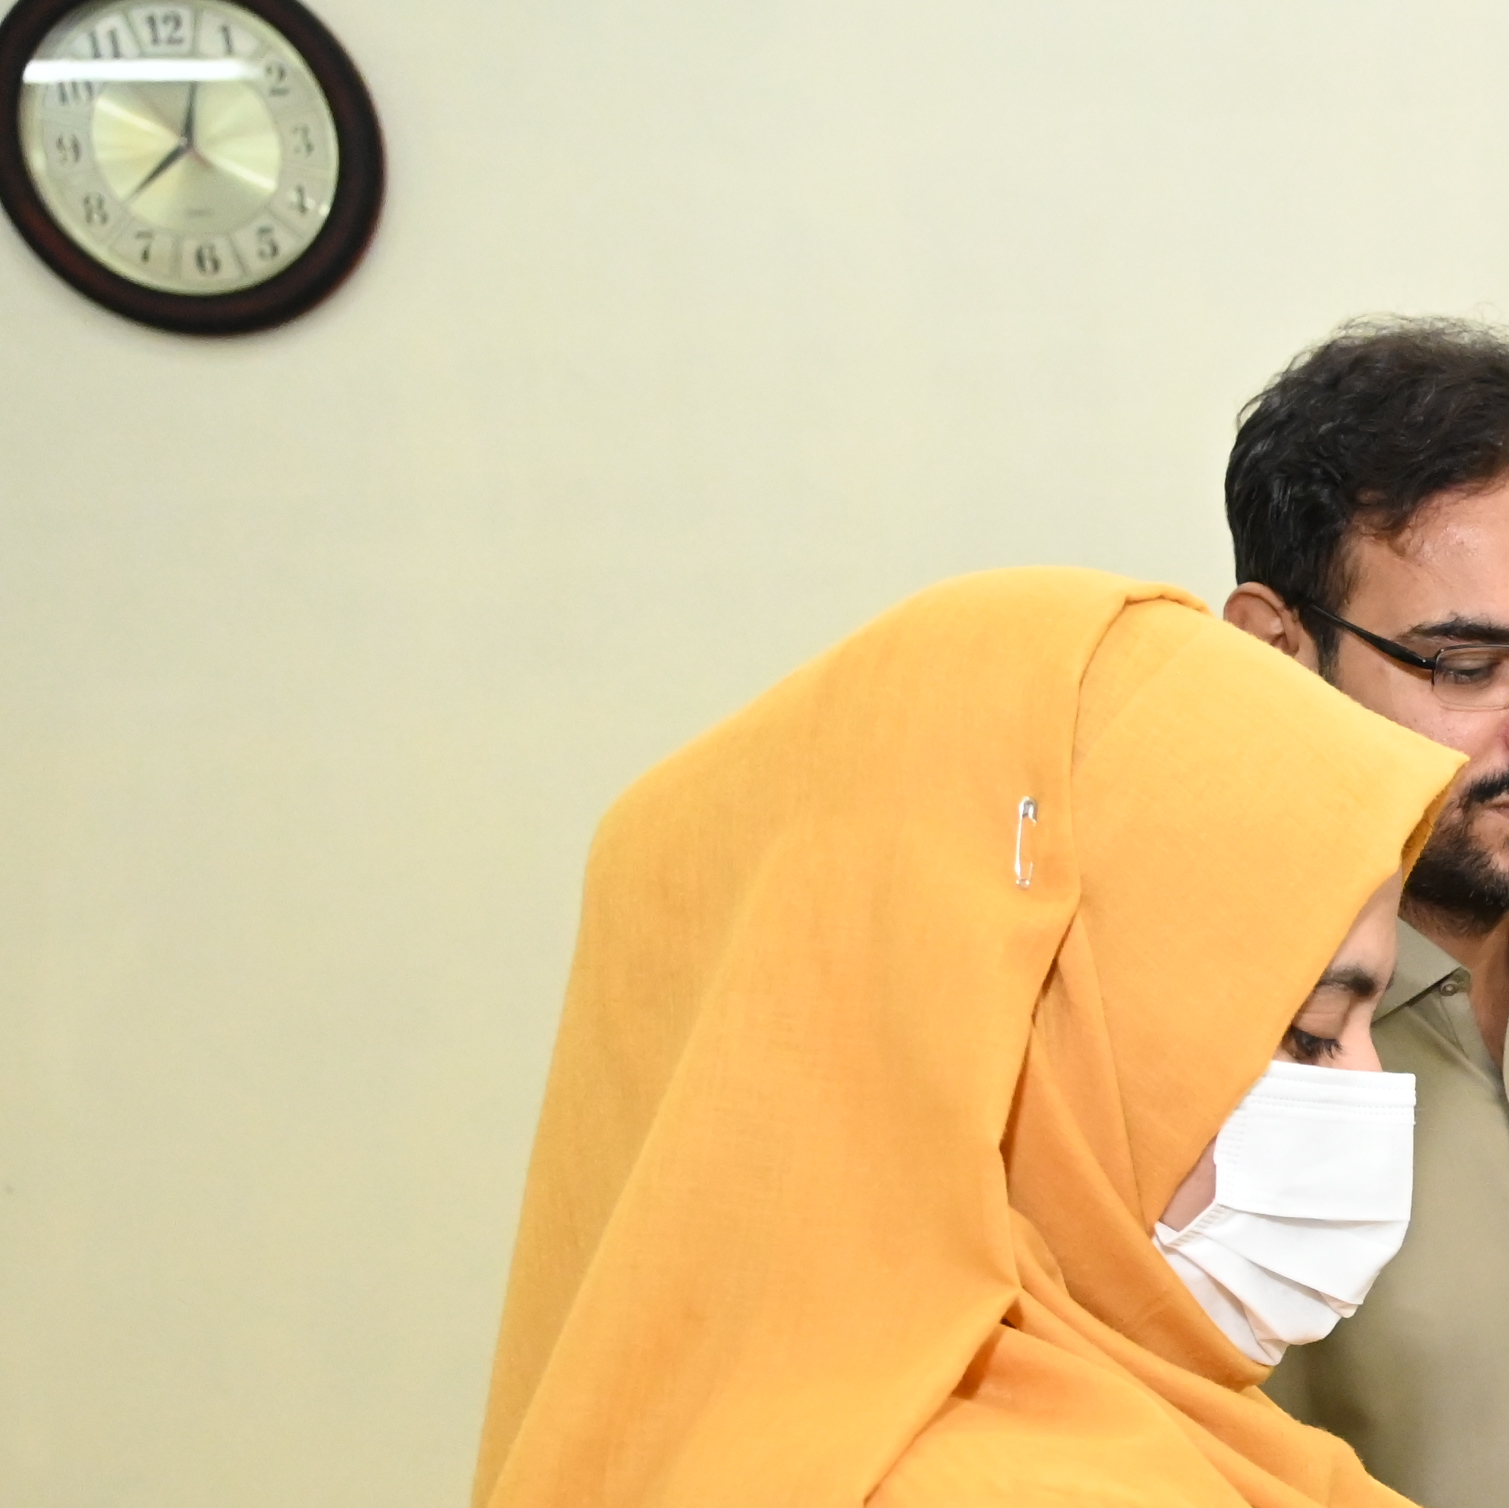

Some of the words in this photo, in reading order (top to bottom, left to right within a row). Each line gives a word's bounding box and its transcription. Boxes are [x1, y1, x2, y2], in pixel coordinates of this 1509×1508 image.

[88, 28, 122, 59] 11
[147, 11, 184, 46] 12
[219, 25, 235, 56] 1
[264, 63, 291, 97] 2
[56, 136, 82, 164] 9
[294, 125, 315, 157] 3
[82, 194, 109, 226] 8
[136, 229, 155, 263] 7
[195, 243, 222, 274] 6
[257, 226, 281, 261] 5
